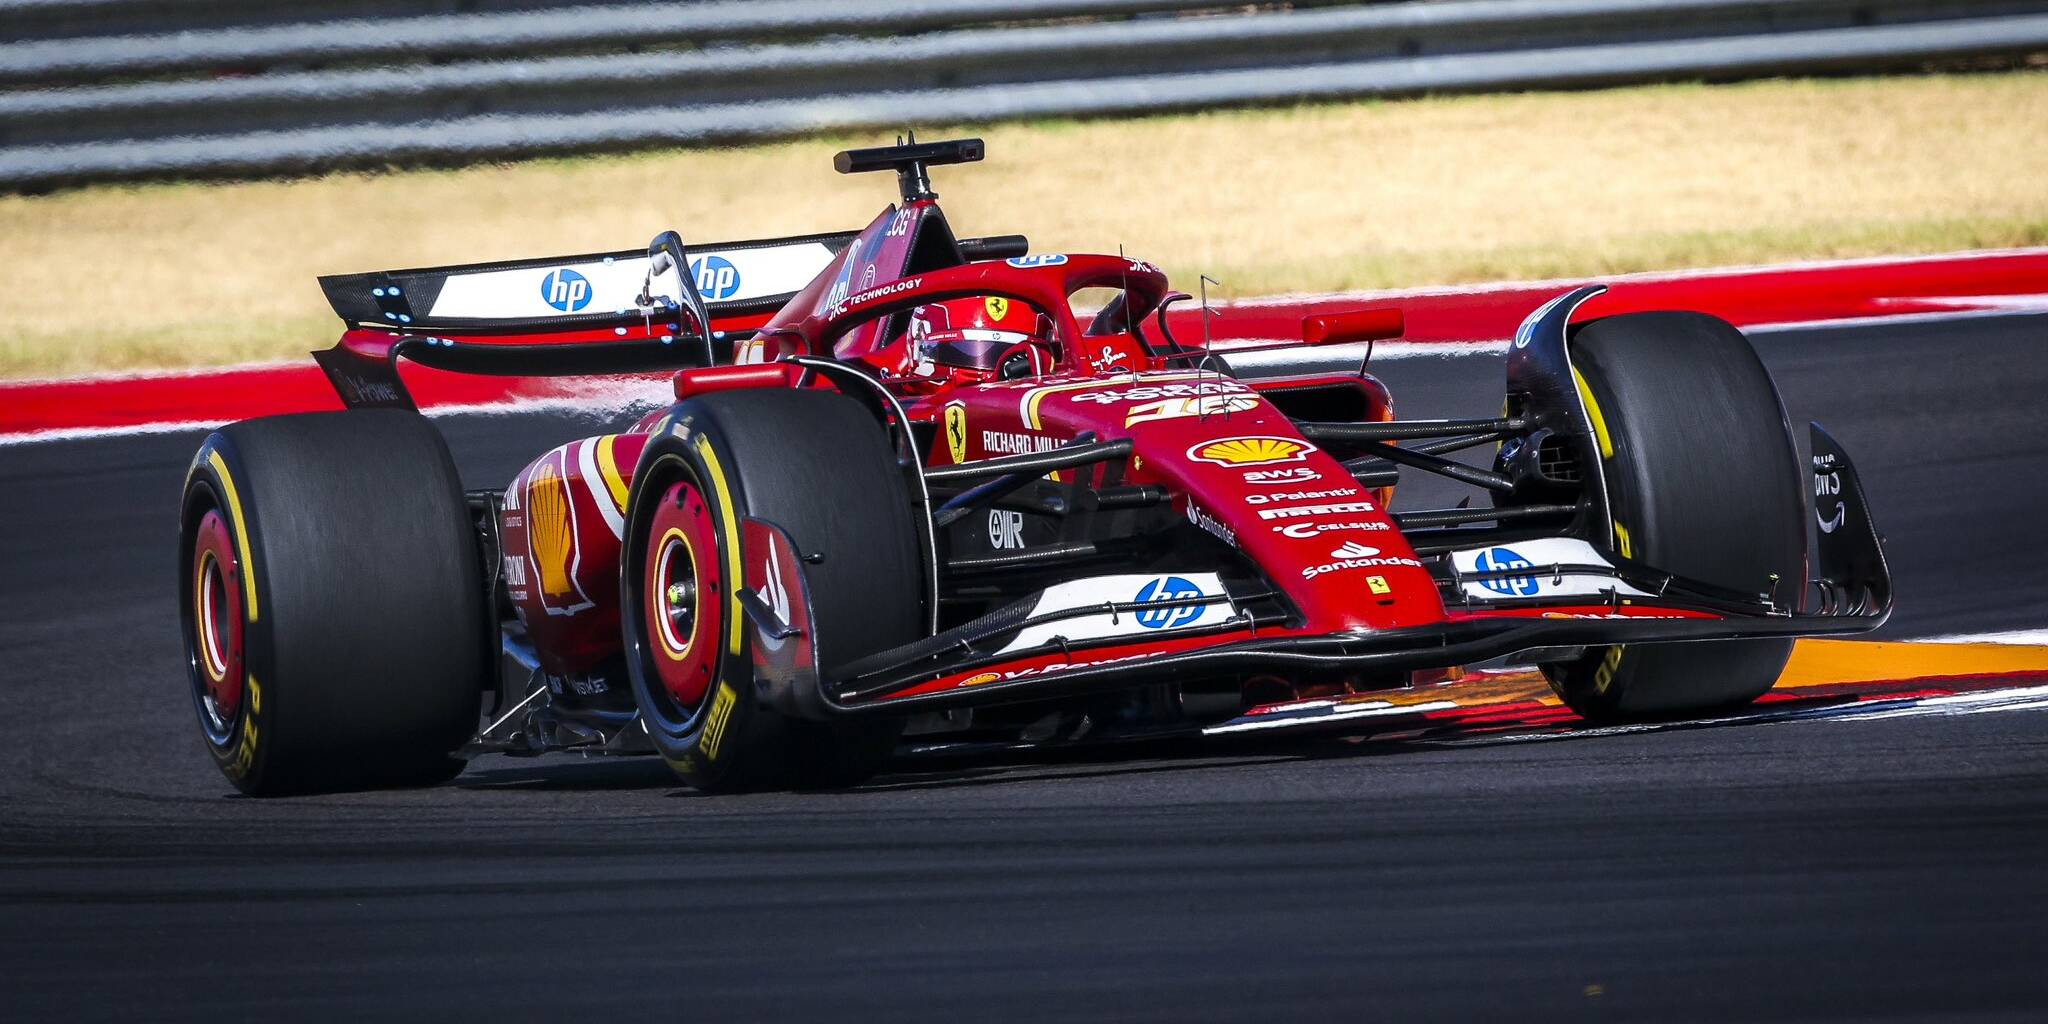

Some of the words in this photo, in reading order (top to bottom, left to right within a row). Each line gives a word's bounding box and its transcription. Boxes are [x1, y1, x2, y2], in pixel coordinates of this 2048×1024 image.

[695, 257, 735, 300] hp
[549, 270, 588, 312] hp
[850, 278, 922, 306] TECHNOLOGY
[1090, 346, 1127, 370] ay-Ban
[982, 430, 1032, 454] RICHARD
[1243, 467, 1317, 482] aws
[1269, 488, 1358, 502] Palantir
[1257, 502, 1375, 520] PIRELLI
[1316, 521, 1389, 532] CELSIUS
[1301, 556, 1424, 580] Santander
[1483, 548, 1532, 596] hp
[1141, 577, 1201, 629] hp
